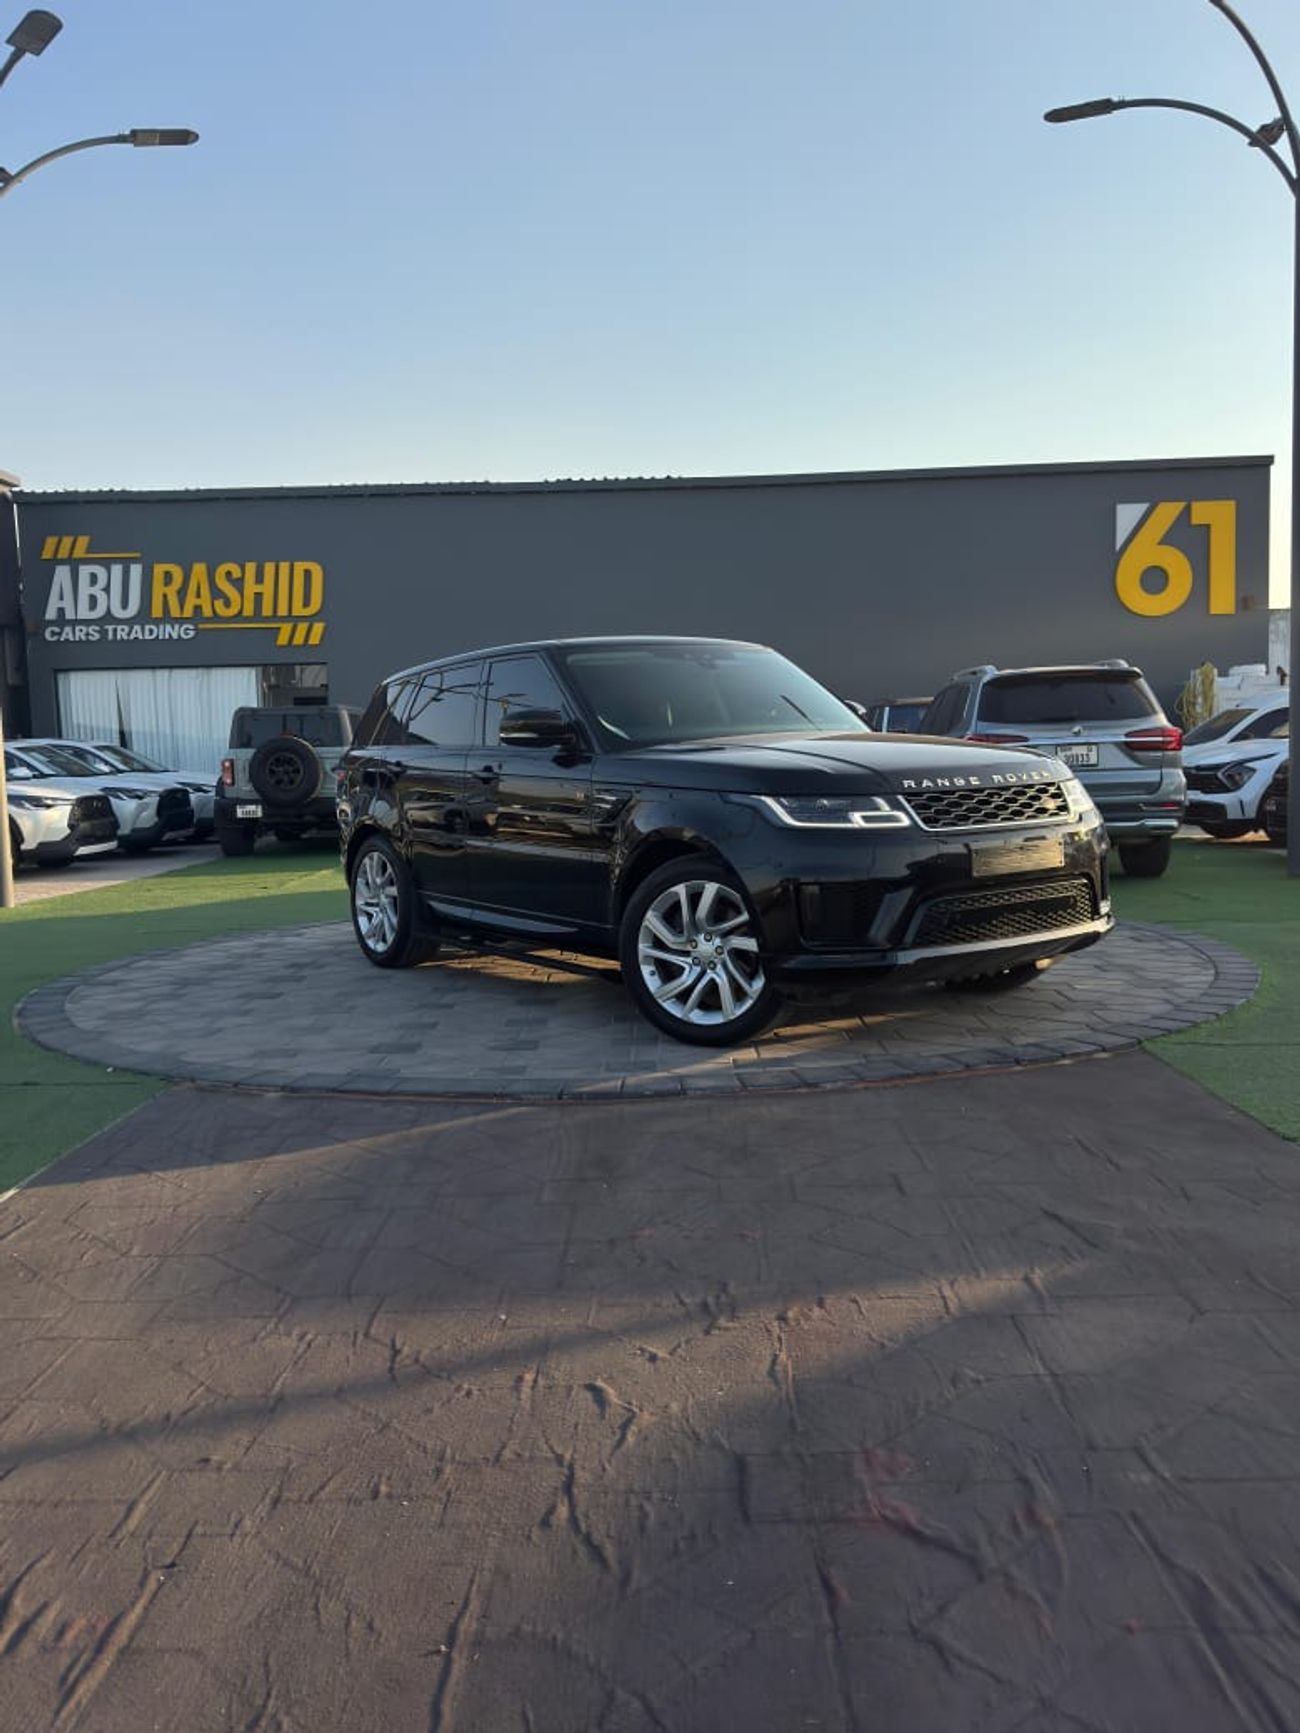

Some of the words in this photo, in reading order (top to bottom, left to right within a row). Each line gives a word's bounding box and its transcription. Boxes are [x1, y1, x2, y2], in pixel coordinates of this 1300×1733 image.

[1115, 500, 1237, 617] 61
[45, 563, 143, 620] ABU
[151, 562, 325, 618] RASHID
[44, 625, 100, 642] CARS
[103, 623, 197, 641] TRADING
[902, 776, 981, 788] RANGE
